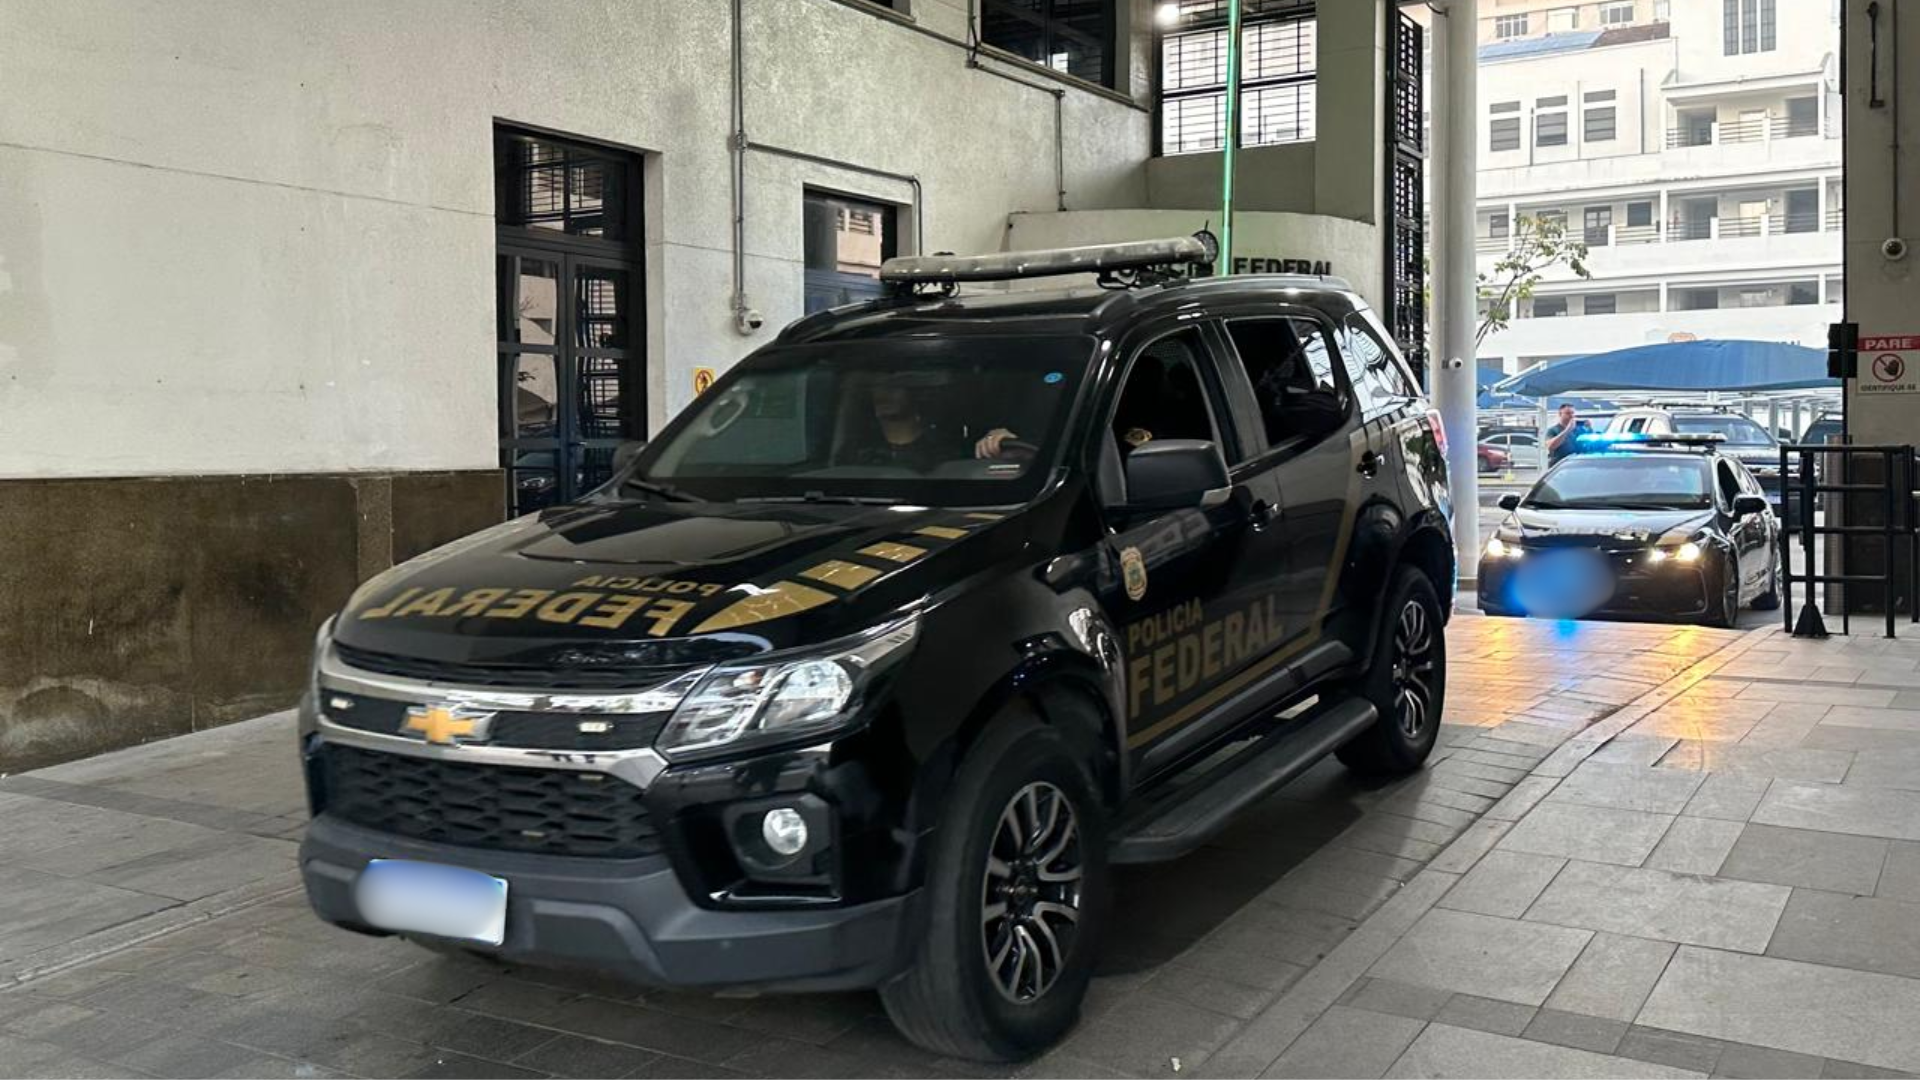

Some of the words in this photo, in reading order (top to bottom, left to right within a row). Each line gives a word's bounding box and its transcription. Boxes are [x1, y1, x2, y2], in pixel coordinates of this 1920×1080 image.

[1865, 338, 1912, 350] PARE
[1128, 596, 1203, 655] POLICIA
[1128, 593, 1283, 719] FEDERAL
